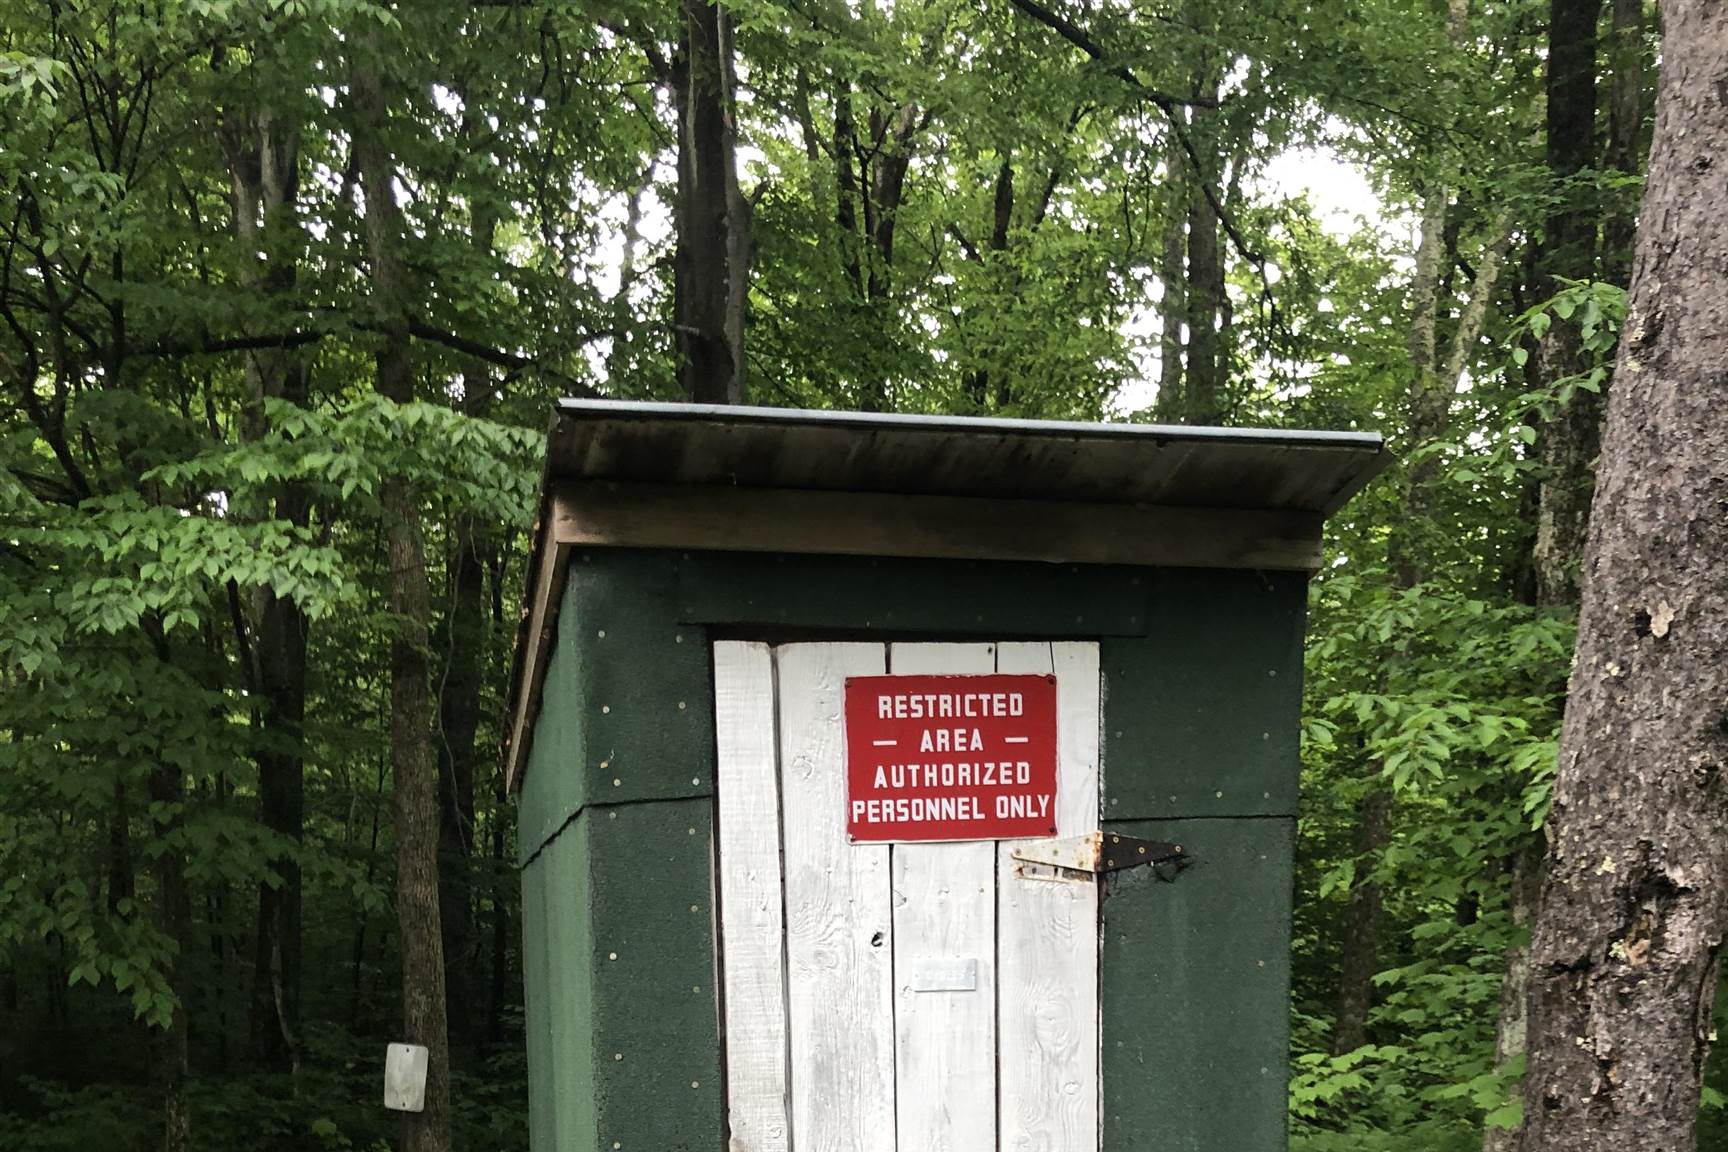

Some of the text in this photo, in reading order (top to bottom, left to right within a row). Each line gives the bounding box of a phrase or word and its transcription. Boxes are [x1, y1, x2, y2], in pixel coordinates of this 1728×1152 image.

[878, 692, 1023, 719] RESTRICTED
[919, 728, 984, 752] AREA
[873, 761, 1030, 789] AUTHORIZED
[852, 794, 1050, 823] PERSONNEL ONLY
